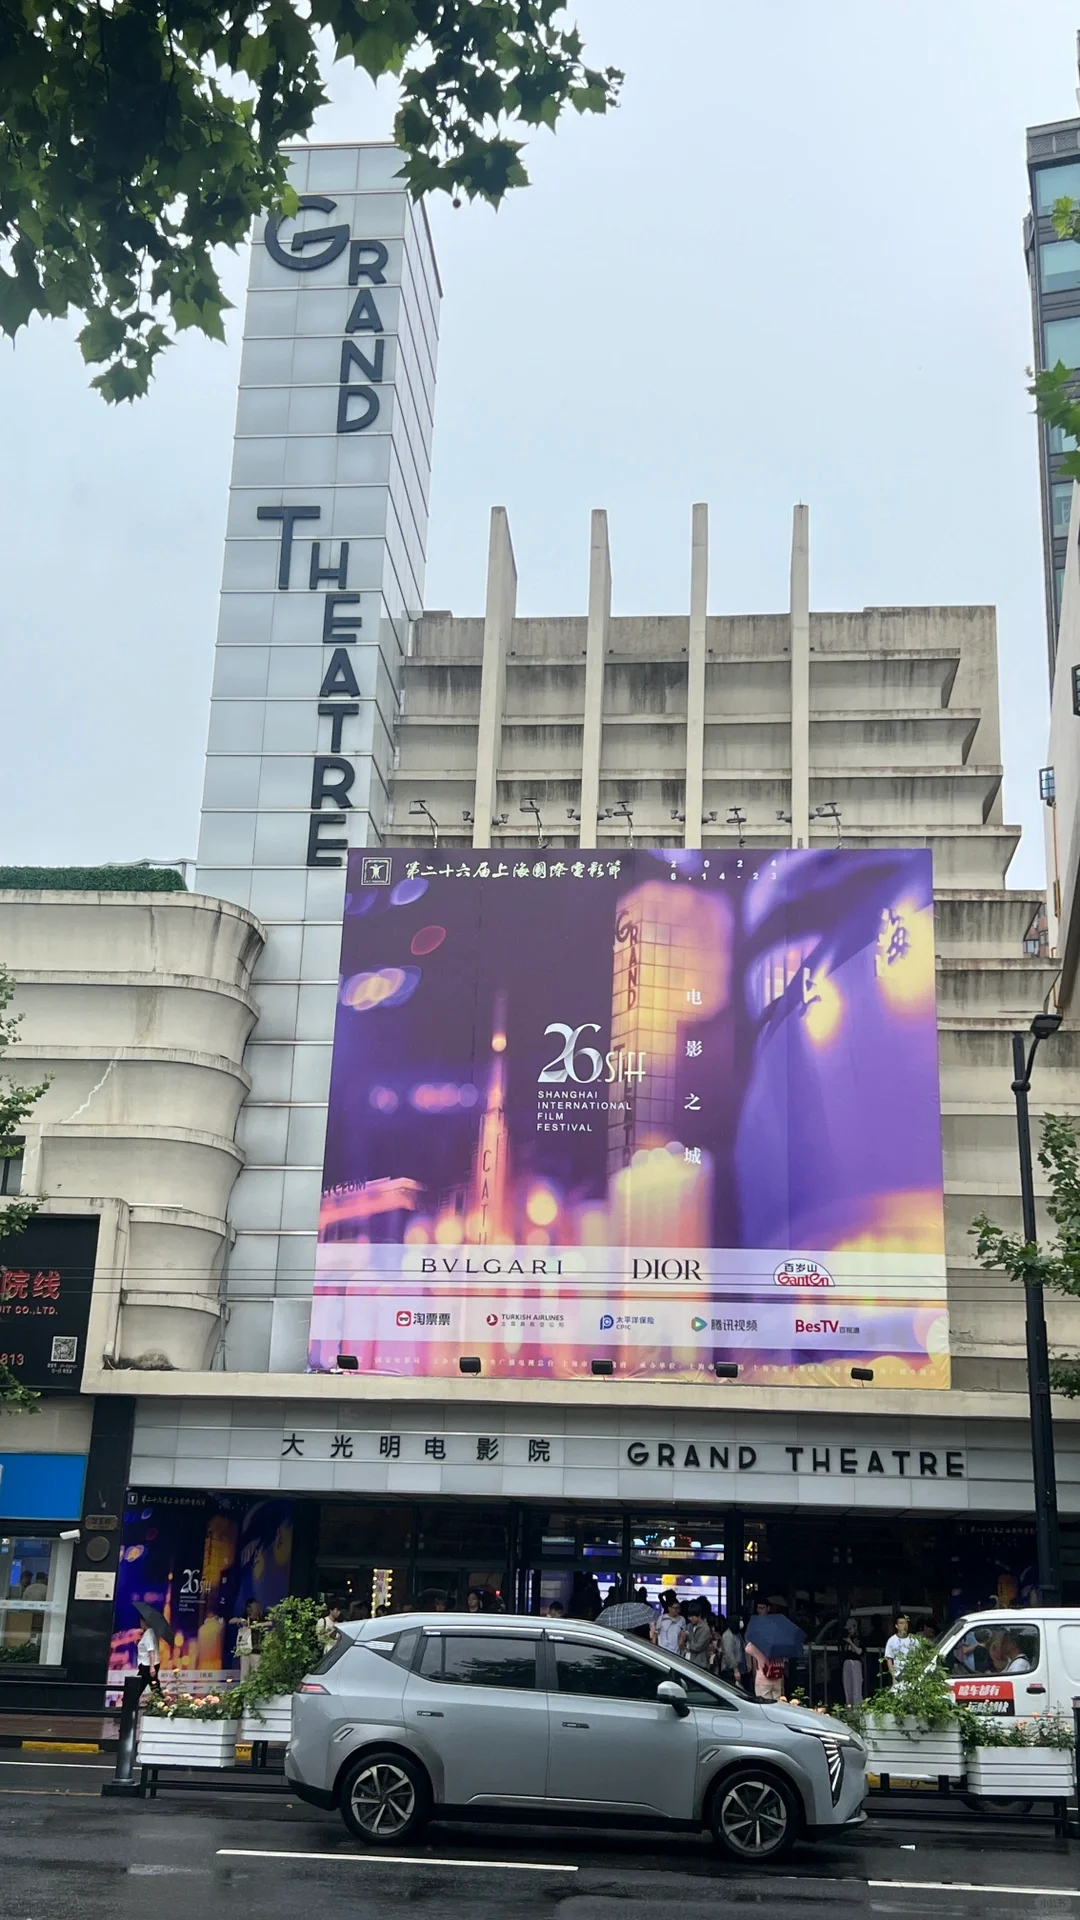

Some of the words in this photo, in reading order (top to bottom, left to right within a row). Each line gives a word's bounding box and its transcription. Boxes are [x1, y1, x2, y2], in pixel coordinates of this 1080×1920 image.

[264, 195, 389, 433] GRAND
[256, 505, 362, 867] THEATRE
[538, 1022, 604, 1084] 26
[537, 1090, 598, 1099] SHANGHAI
[537, 1101, 632, 1110] INTERNATIONAL
[537, 1112, 564, 1120] FILM
[536, 1123, 593, 1132] FESTIVAL
[421, 1258, 563, 1275] BVLGARI
[632, 1258, 703, 1281] DIOR
[784, 1263, 818, 1273] 百岁山
[413, 1312, 451, 1326] 淘票票
[501, 1313, 532, 1321] TURKISH
[533, 1314, 565, 1322] AIRLINES
[616, 1316, 655, 1325] 太平洋保险
[711, 1319, 758, 1332] 腾讯视频
[795, 1319, 839, 1334] BesTV
[281, 1433, 551, 1463] 大光明电影院
[627, 1442, 757, 1470] GRAND
[785, 1446, 965, 1478] THEATRE
[180, 1568, 200, 1594] 26
